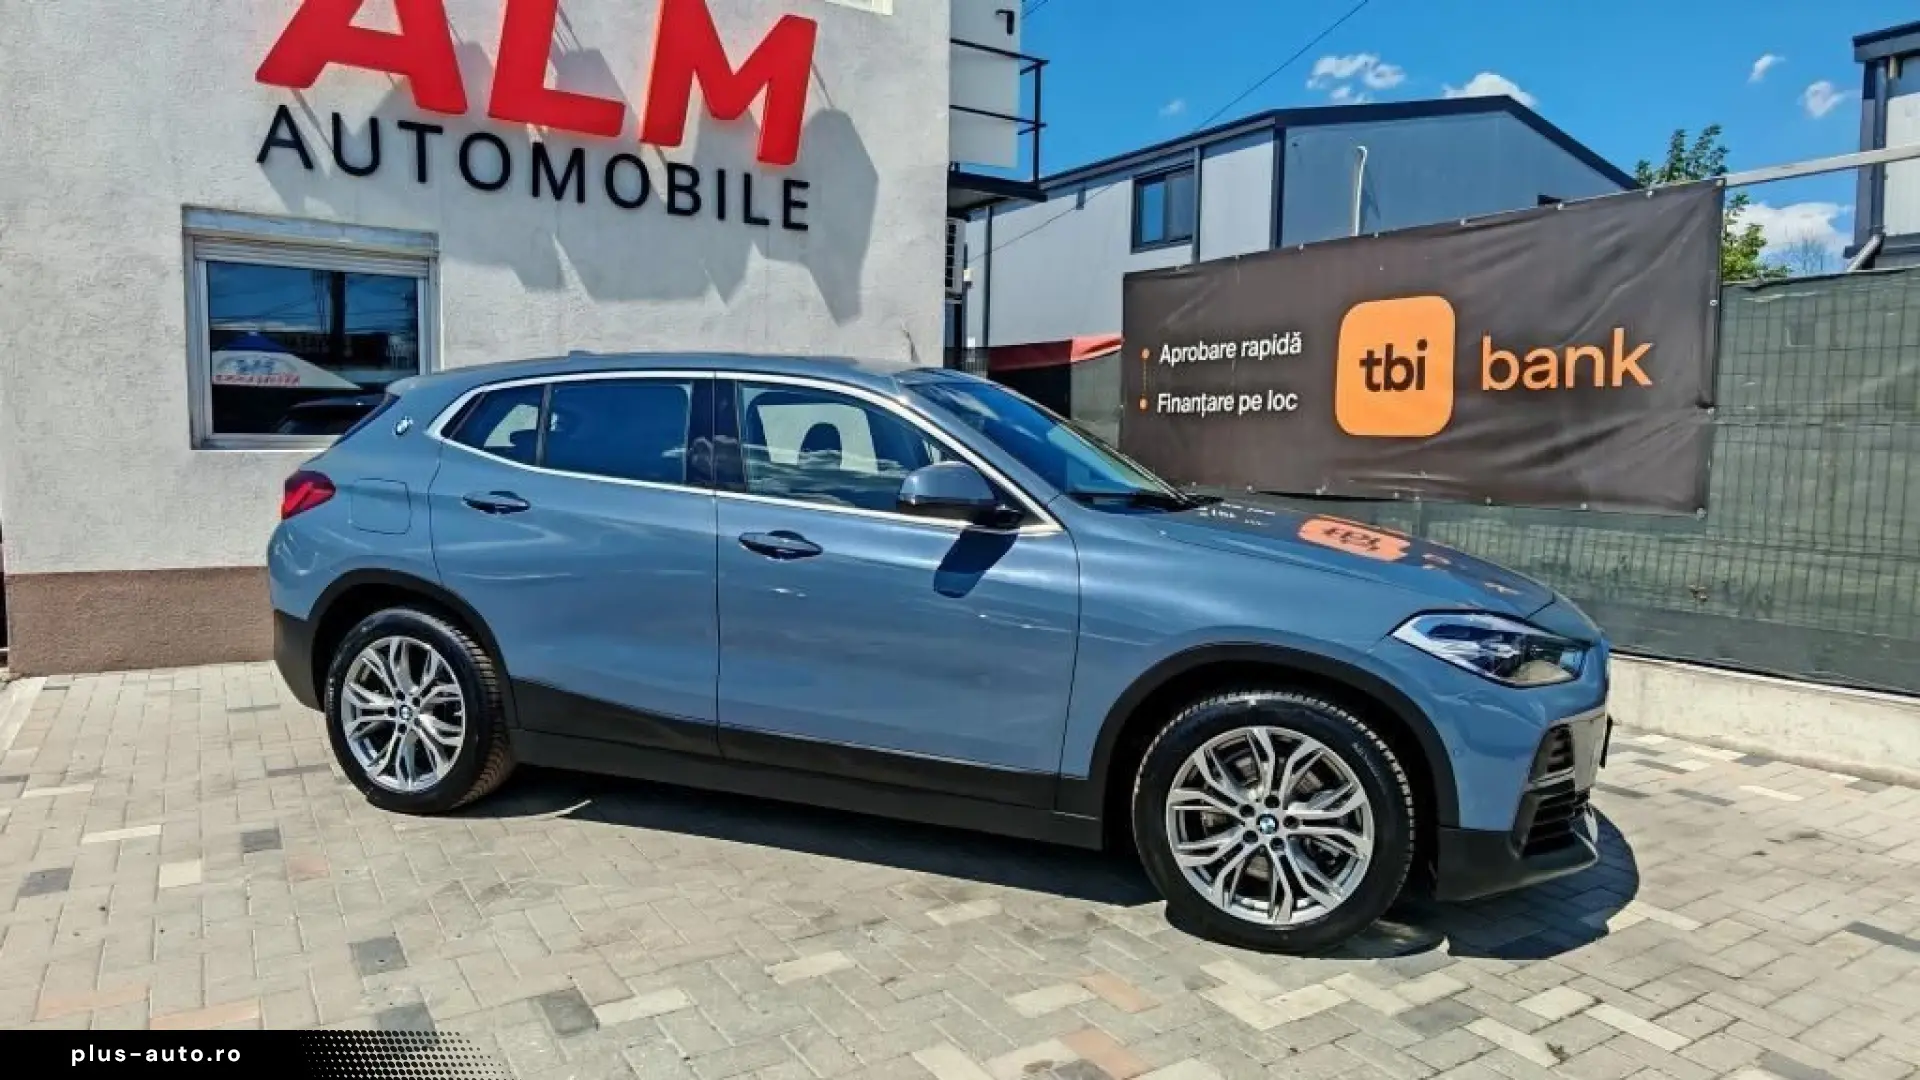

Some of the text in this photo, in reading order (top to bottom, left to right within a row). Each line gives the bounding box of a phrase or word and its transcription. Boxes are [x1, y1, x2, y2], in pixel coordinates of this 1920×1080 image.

[256, 0, 817, 166] ALM
[256, 104, 810, 232] AUTOMOBILE
[1159, 331, 1302, 367] Aprobare rapidă
[1359, 327, 1653, 392] tbi bank
[1238, 394, 1263, 416] pe
[1267, 389, 1298, 412] loc
